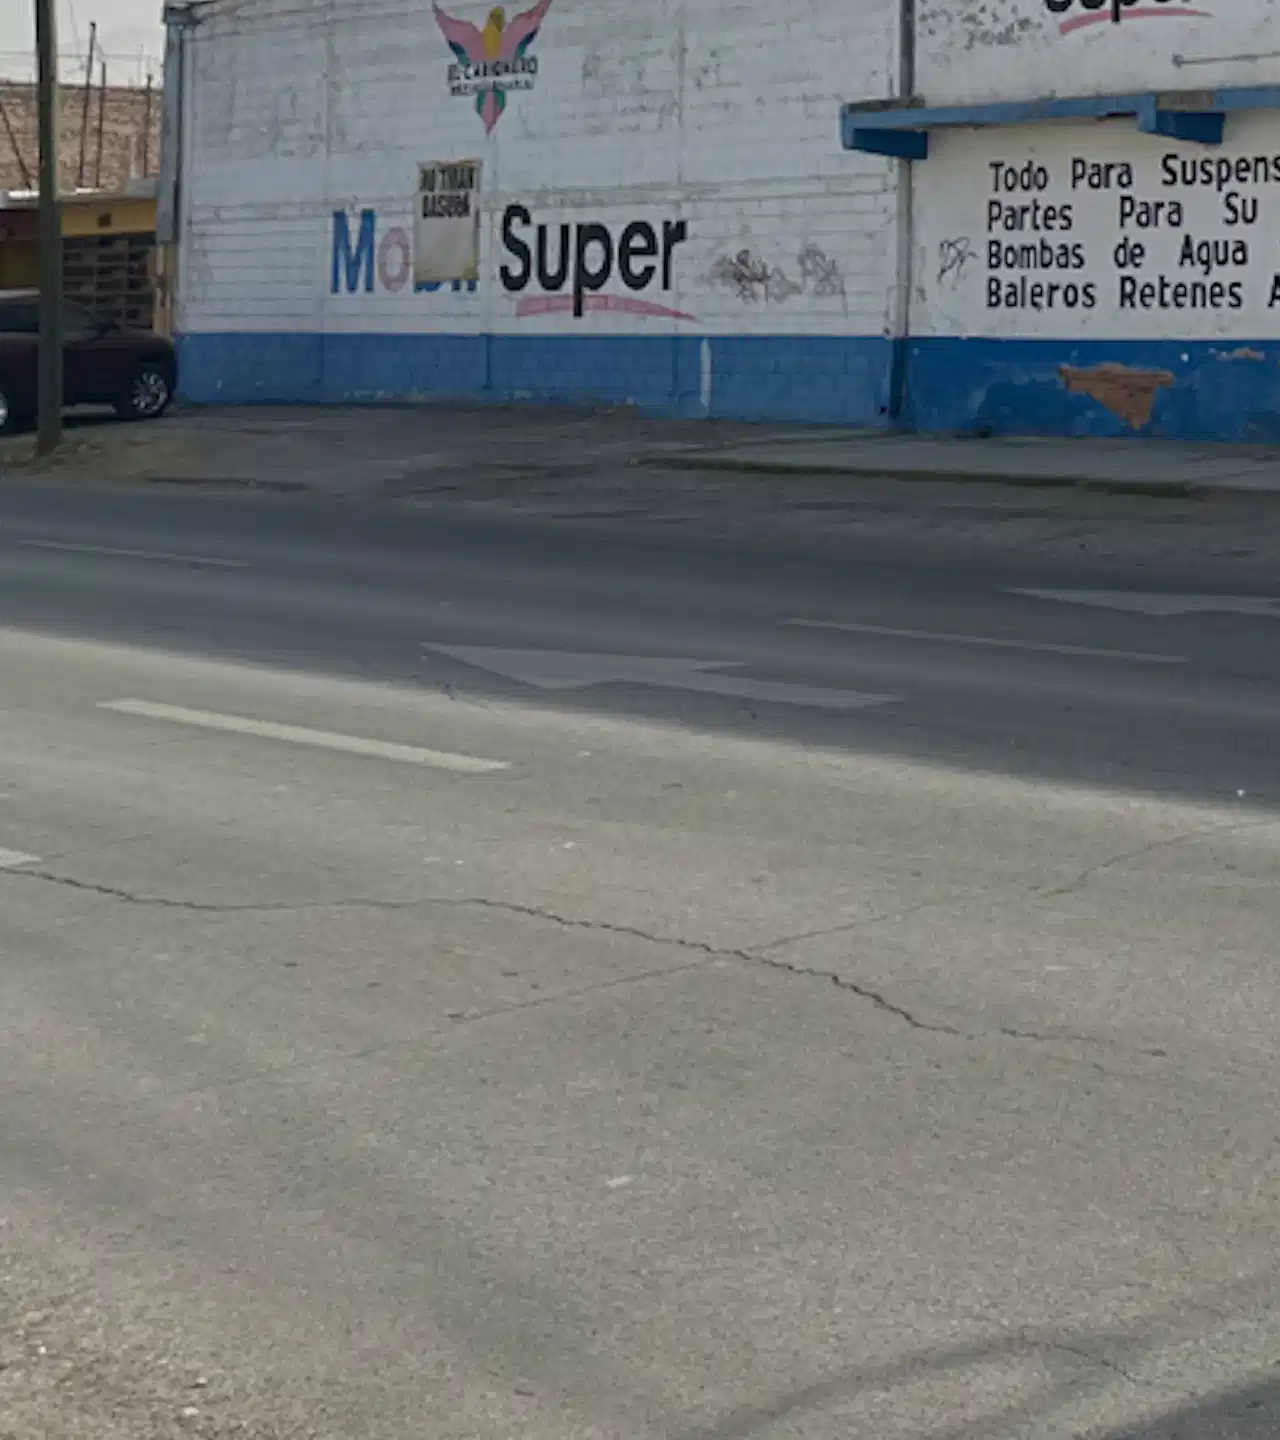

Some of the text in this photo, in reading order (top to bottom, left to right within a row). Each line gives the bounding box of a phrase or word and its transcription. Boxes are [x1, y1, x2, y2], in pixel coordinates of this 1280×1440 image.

[988, 160, 1047, 192] Todo
[1072, 157, 1132, 189] Para
[988, 198, 1072, 232] Partes
[1119, 196, 1184, 228] Para
[1223, 192, 1258, 224] Su
[500, 204, 687, 317] Super
[988, 237, 1085, 269] Bombas
[1114, 236, 1145, 268] de
[1178, 234, 1248, 275] Agua
[986, 275, 1097, 309] Baleros
[1119, 275, 1243, 309] Retenes
